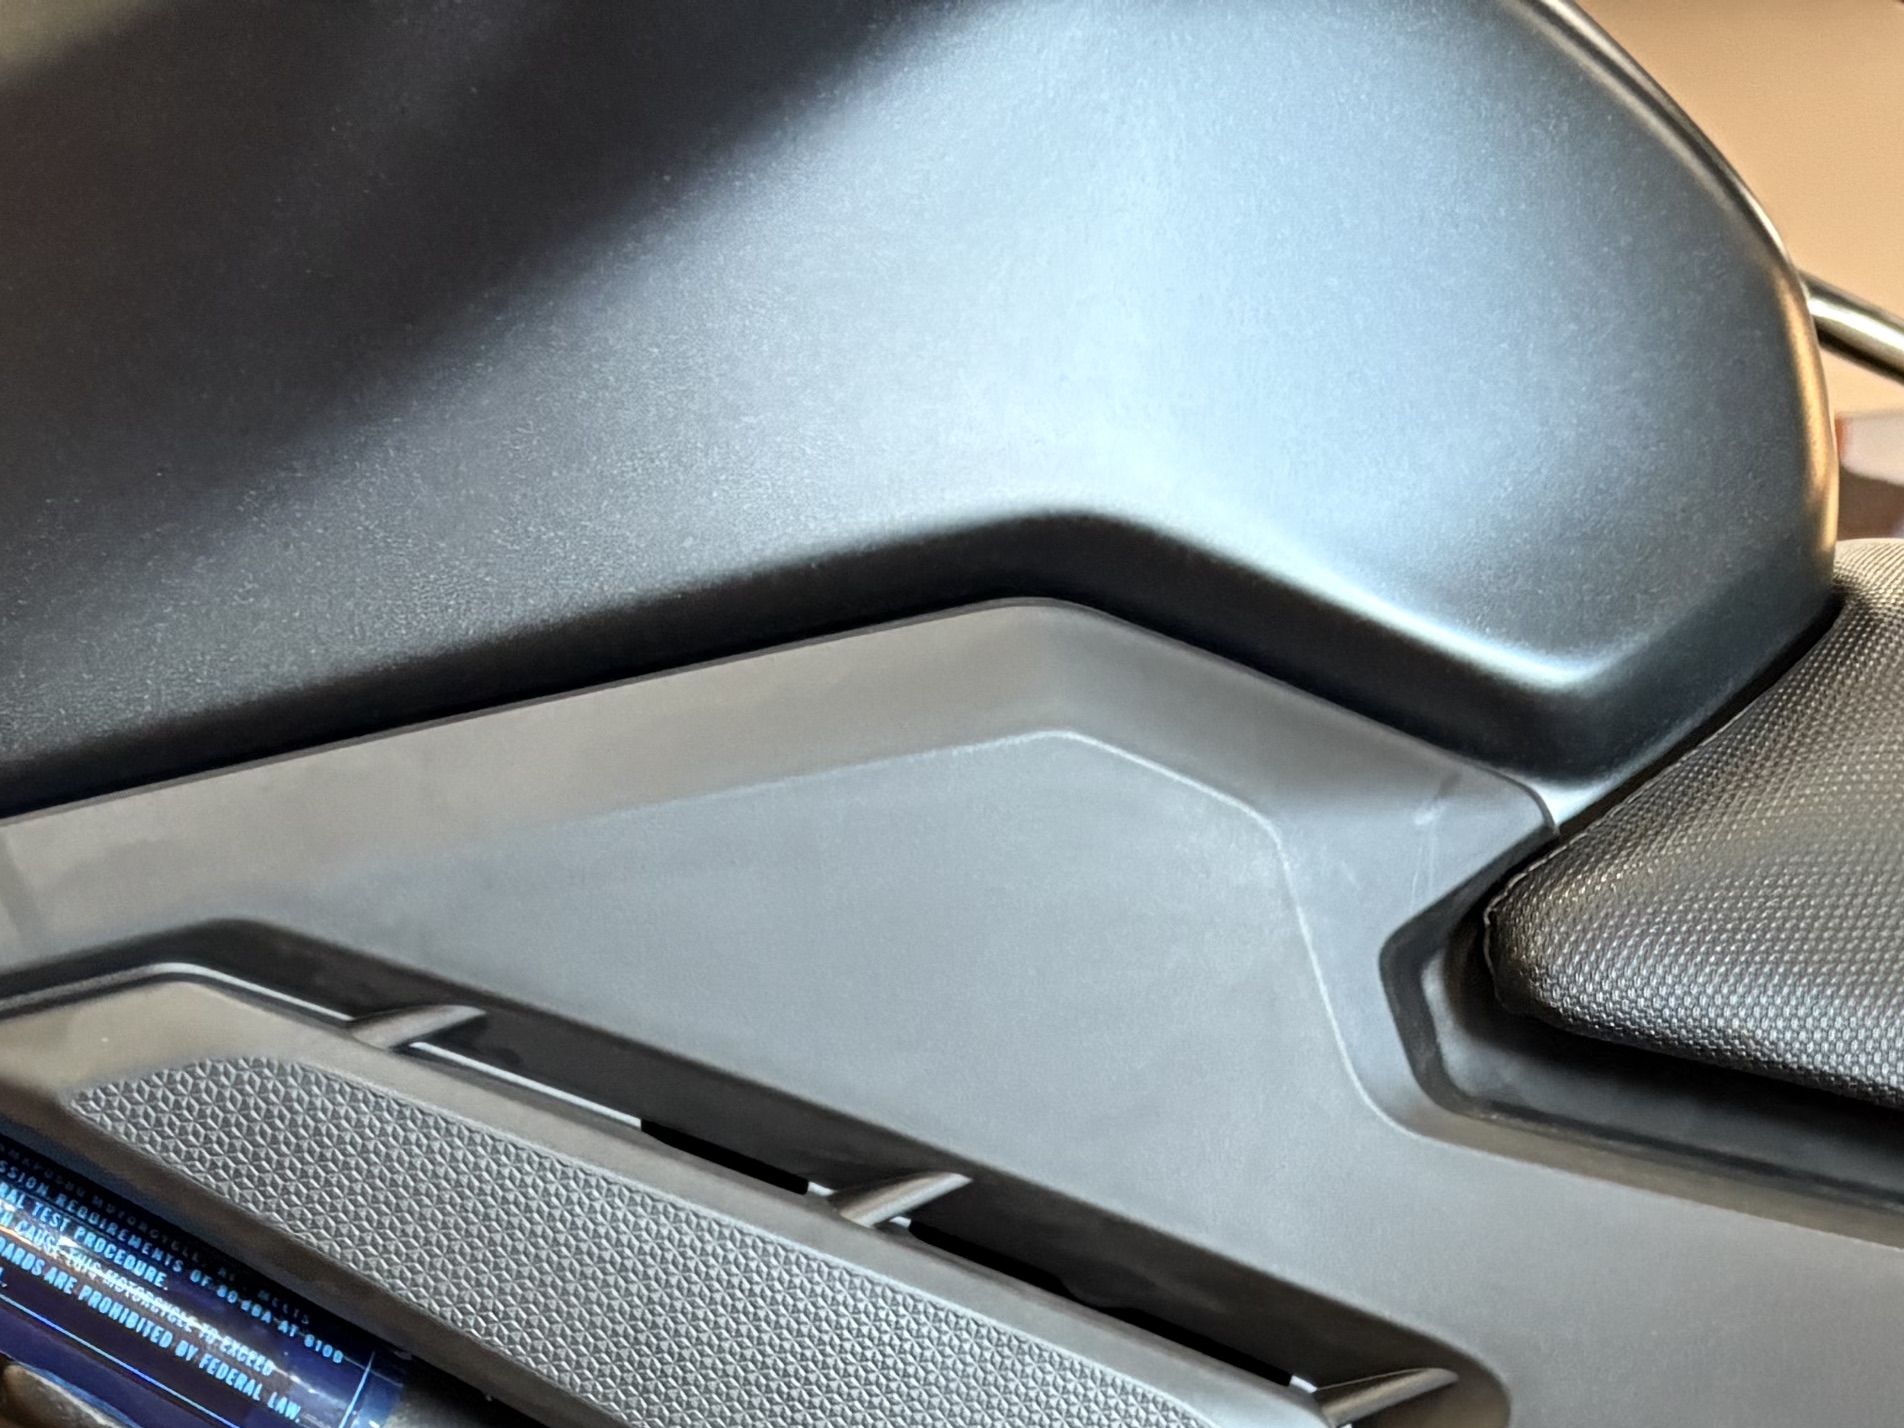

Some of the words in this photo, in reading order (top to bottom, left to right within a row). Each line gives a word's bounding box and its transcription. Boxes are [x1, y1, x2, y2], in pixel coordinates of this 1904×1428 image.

[27, 1198, 73, 1235] TEST
[69, 1225, 168, 1291] PROCEDURE.
[43, 1265, 78, 1295] ARE
[77, 1283, 174, 1348] PROHIBITED
[174, 1338, 199, 1361] BY
[198, 1351, 263, 1401] FEDERAL
[266, 1391, 302, 1424] LAW.
[277, 1319, 298, 1337] AT
